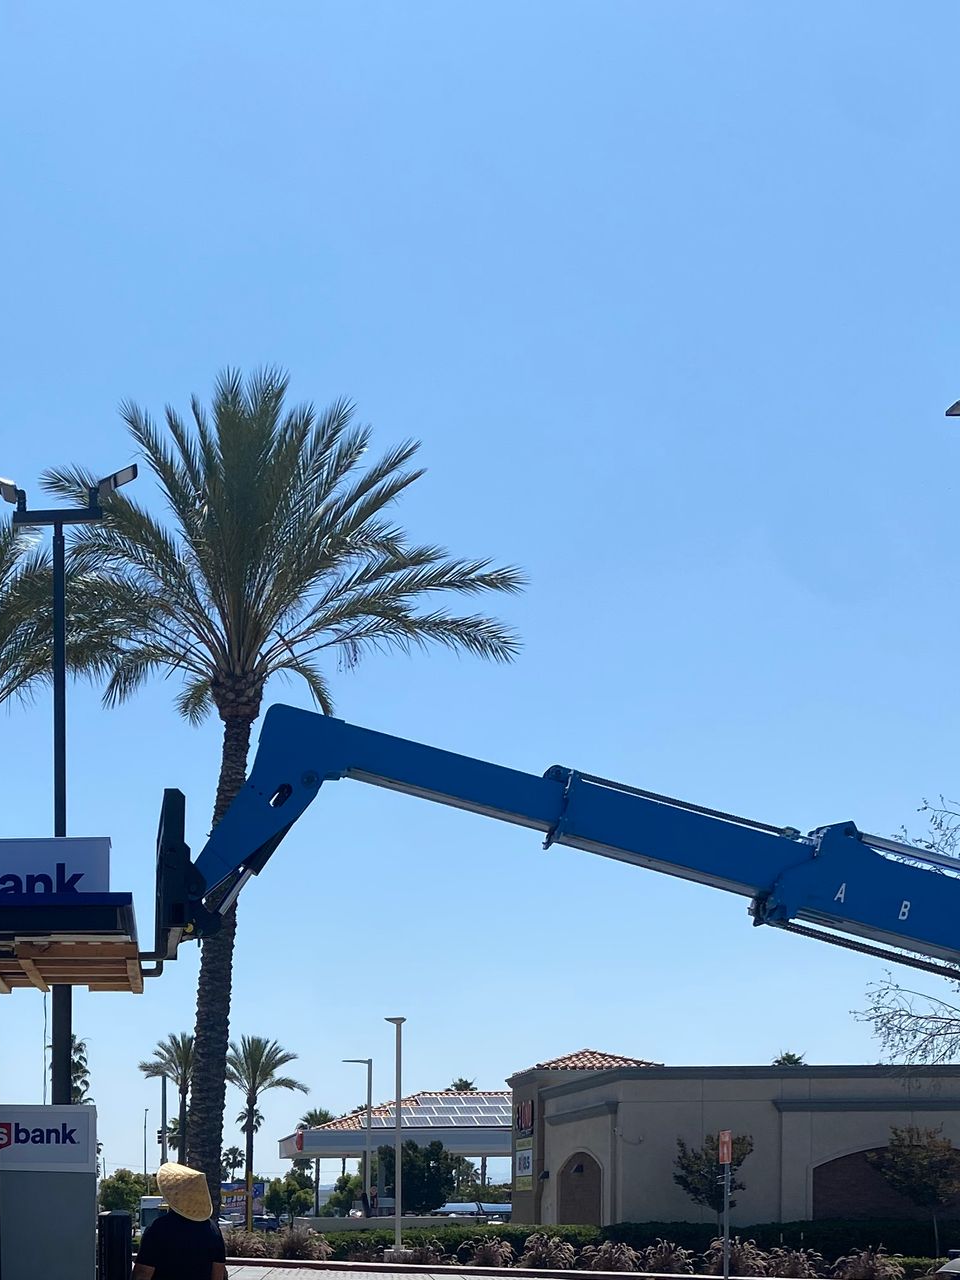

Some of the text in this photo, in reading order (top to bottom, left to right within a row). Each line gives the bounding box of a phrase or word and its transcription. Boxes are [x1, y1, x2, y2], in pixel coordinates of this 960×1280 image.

[834, 882, 846, 903] A
[898, 900, 911, 920] B
[14, 1122, 77, 1145] bank
